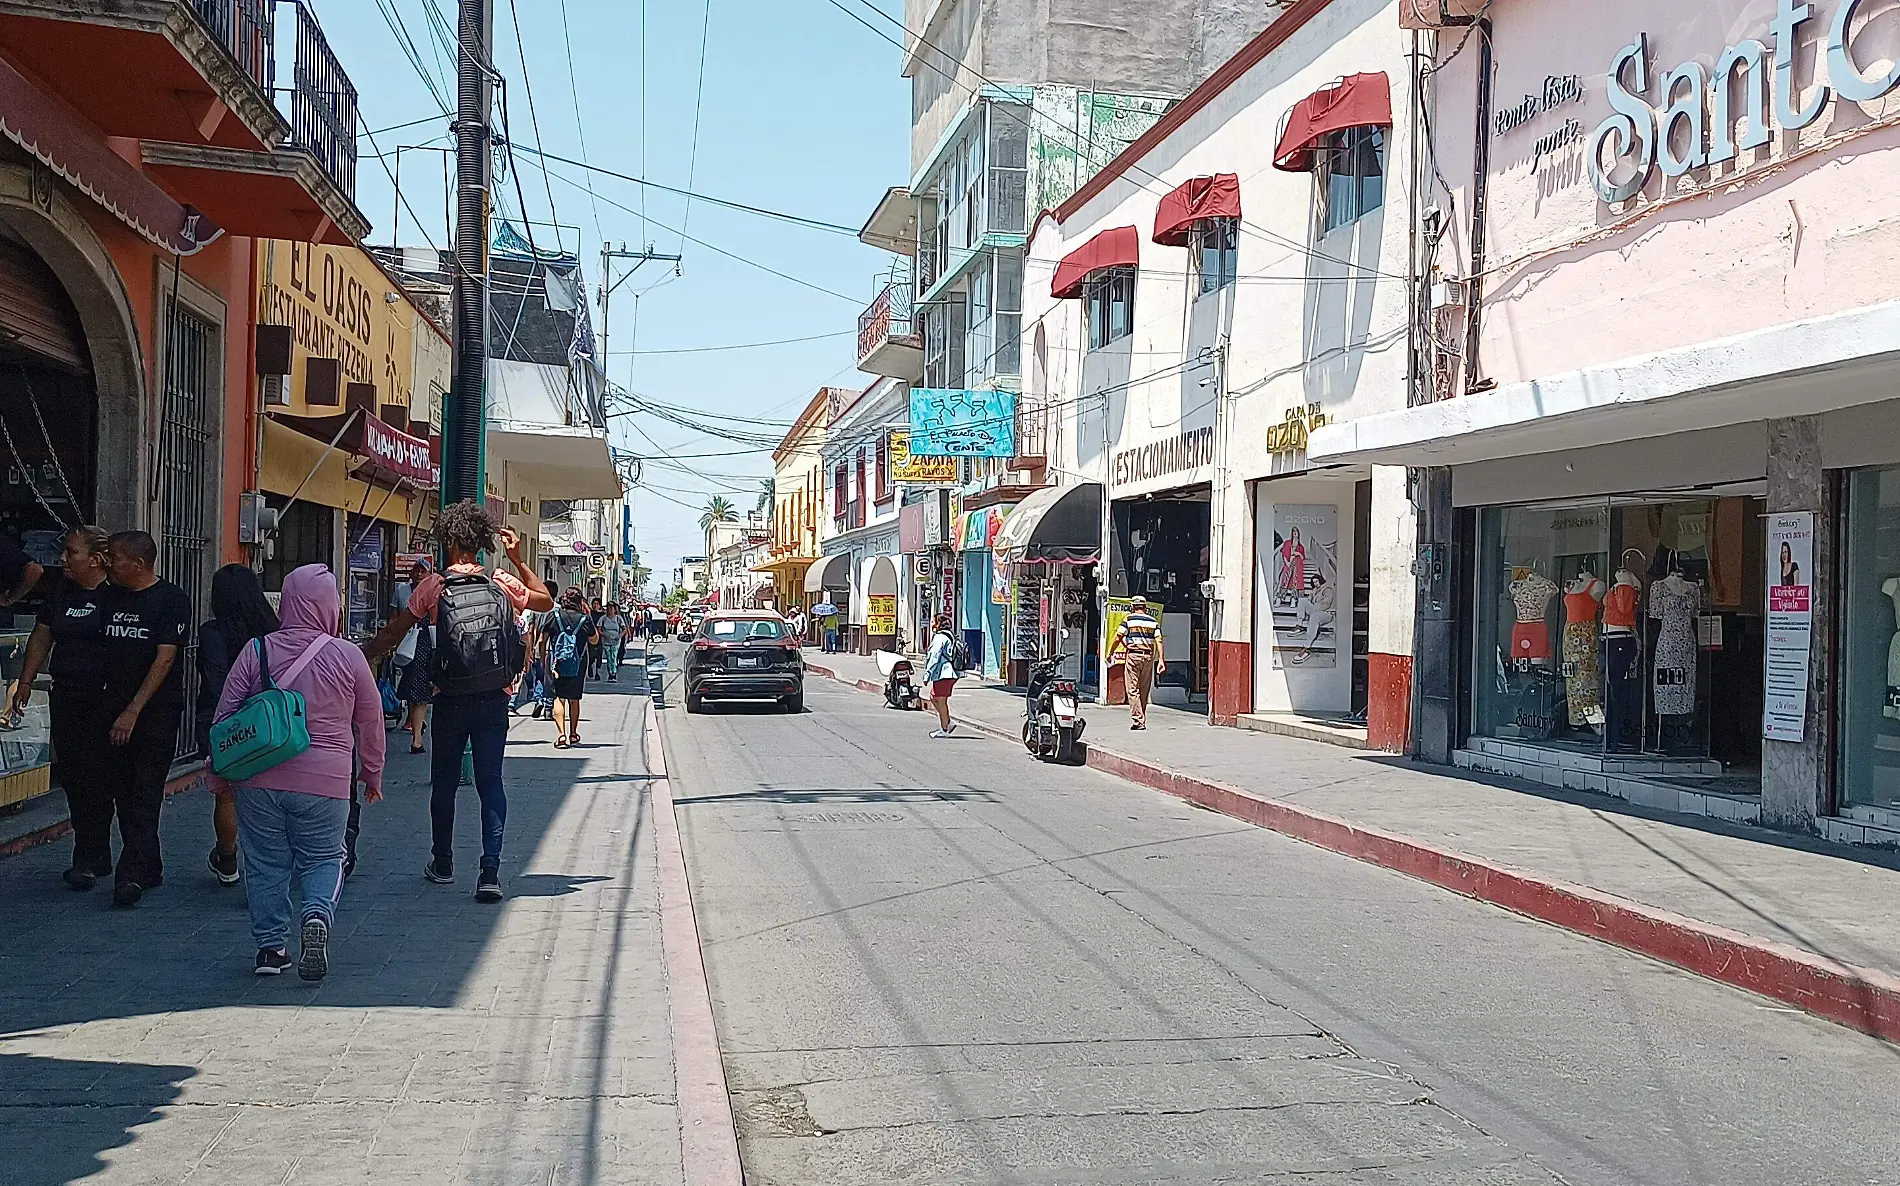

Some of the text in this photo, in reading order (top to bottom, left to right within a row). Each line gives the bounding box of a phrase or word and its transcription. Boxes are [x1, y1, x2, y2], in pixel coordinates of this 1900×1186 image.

[1495, 75, 1583, 137] Ponte lista,
[290, 240, 371, 345] EL OASIS
[338, 334, 373, 384] PIZZERIA
[1116, 425, 1213, 486] ESTACIONAMIENTO
[919, 561, 929, 573] E
[105, 624, 150, 639] nivac
